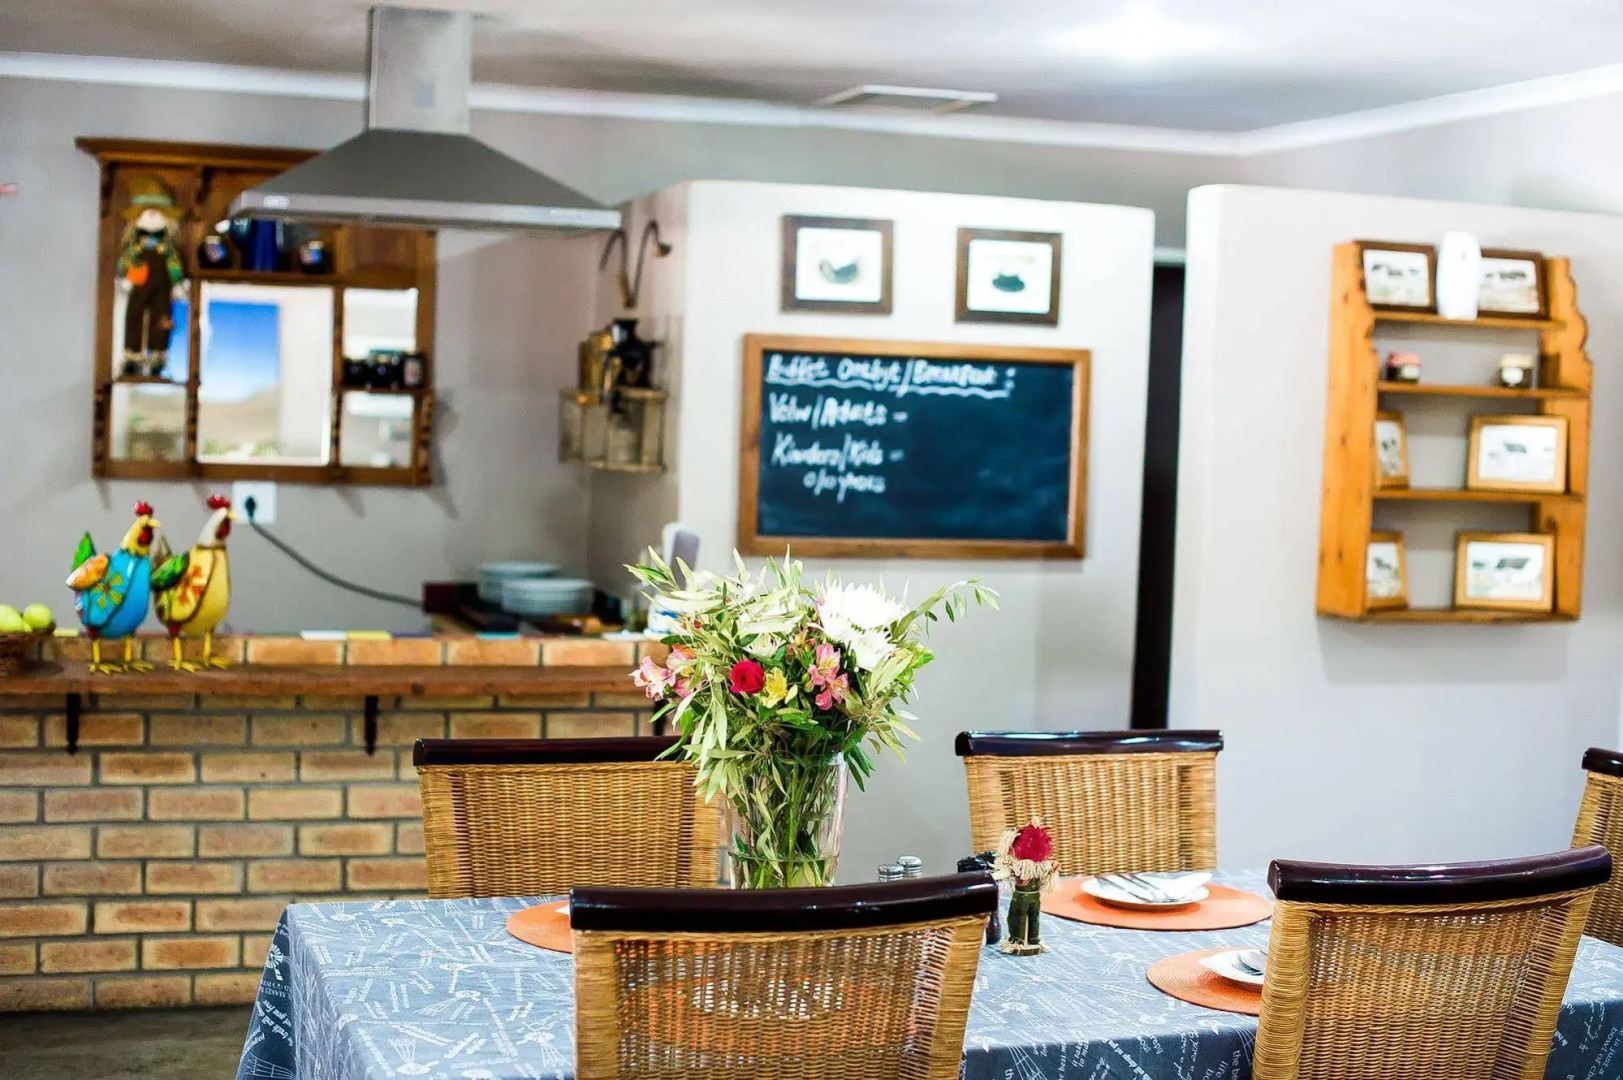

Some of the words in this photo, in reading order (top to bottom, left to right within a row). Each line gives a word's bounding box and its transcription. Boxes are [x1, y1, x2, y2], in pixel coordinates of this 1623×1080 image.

[771, 431, 884, 472] Kinders/Kids
[262, 1000, 276, 1013] free
[261, 1015, 275, 1027] will
[273, 1009, 288, 1020] you
[272, 1024, 289, 1039] truth
[1601, 1026, 1618, 1052] bowl
[1231, 1050, 1242, 1066] the
[1602, 1046, 1616, 1067] just
